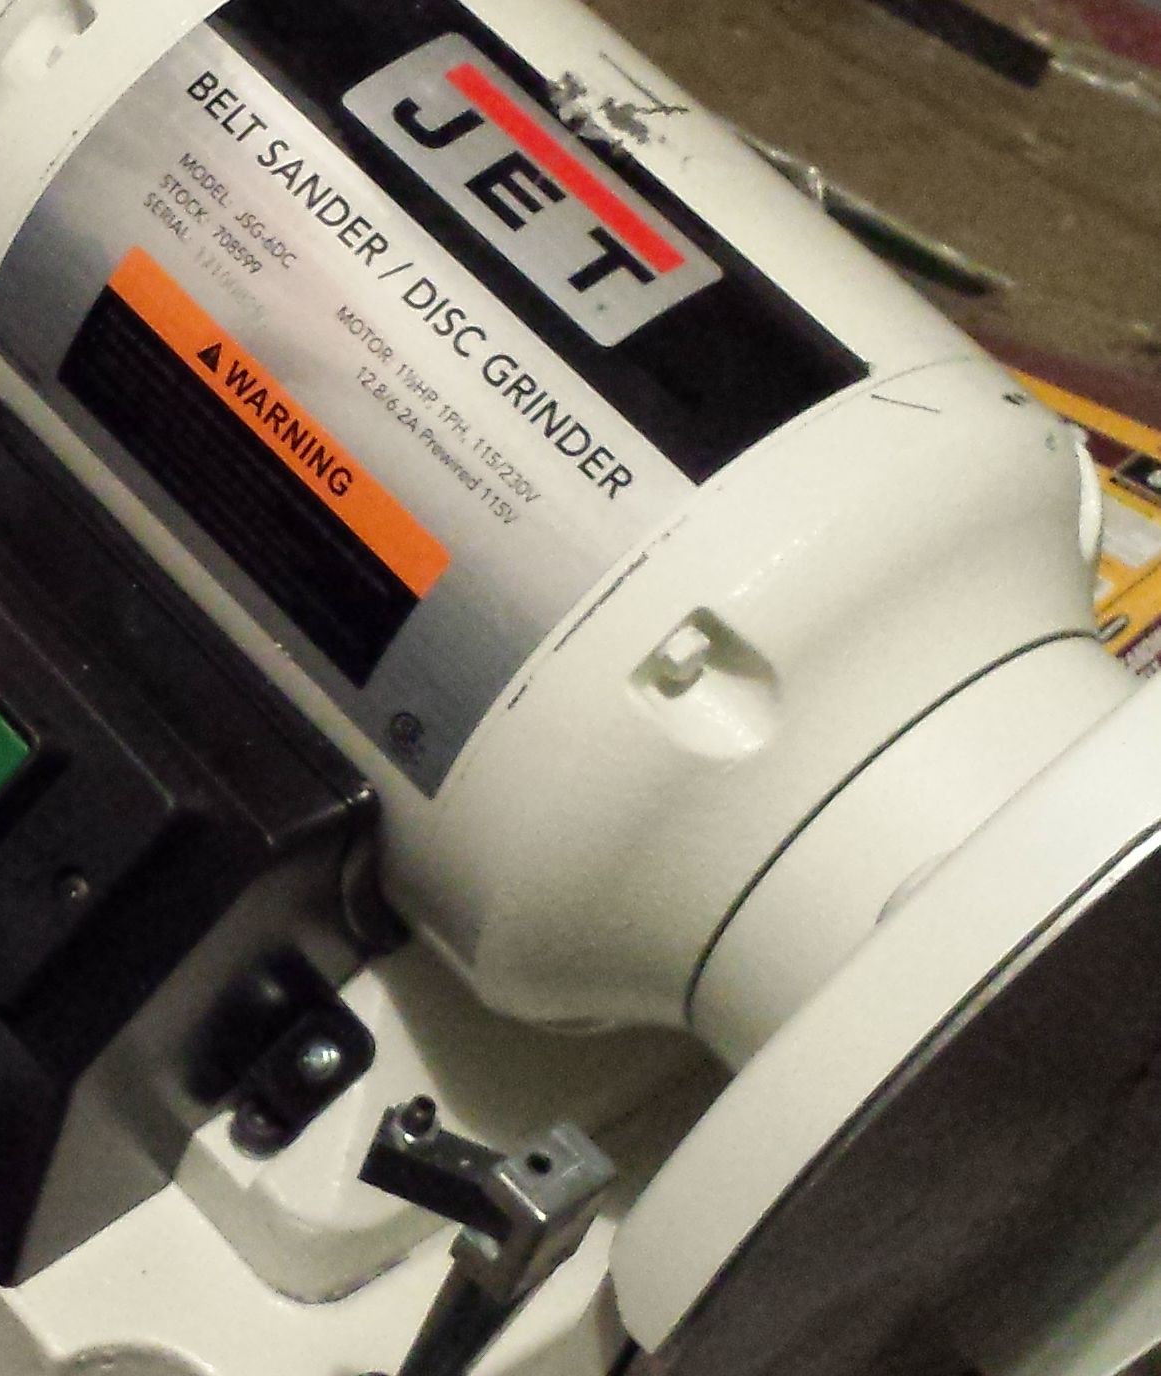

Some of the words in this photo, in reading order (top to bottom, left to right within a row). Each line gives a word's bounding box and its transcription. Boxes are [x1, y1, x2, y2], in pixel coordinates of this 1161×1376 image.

[213, 225, 262, 274] 708599
[393, 97, 656, 293] JET
[186, 71, 267, 142] BELT
[257, 139, 389, 267] SANDER
[401, 276, 487, 358] DISC
[482, 354, 634, 501] GRINDER
[224, 360, 353, 498] WARNING
